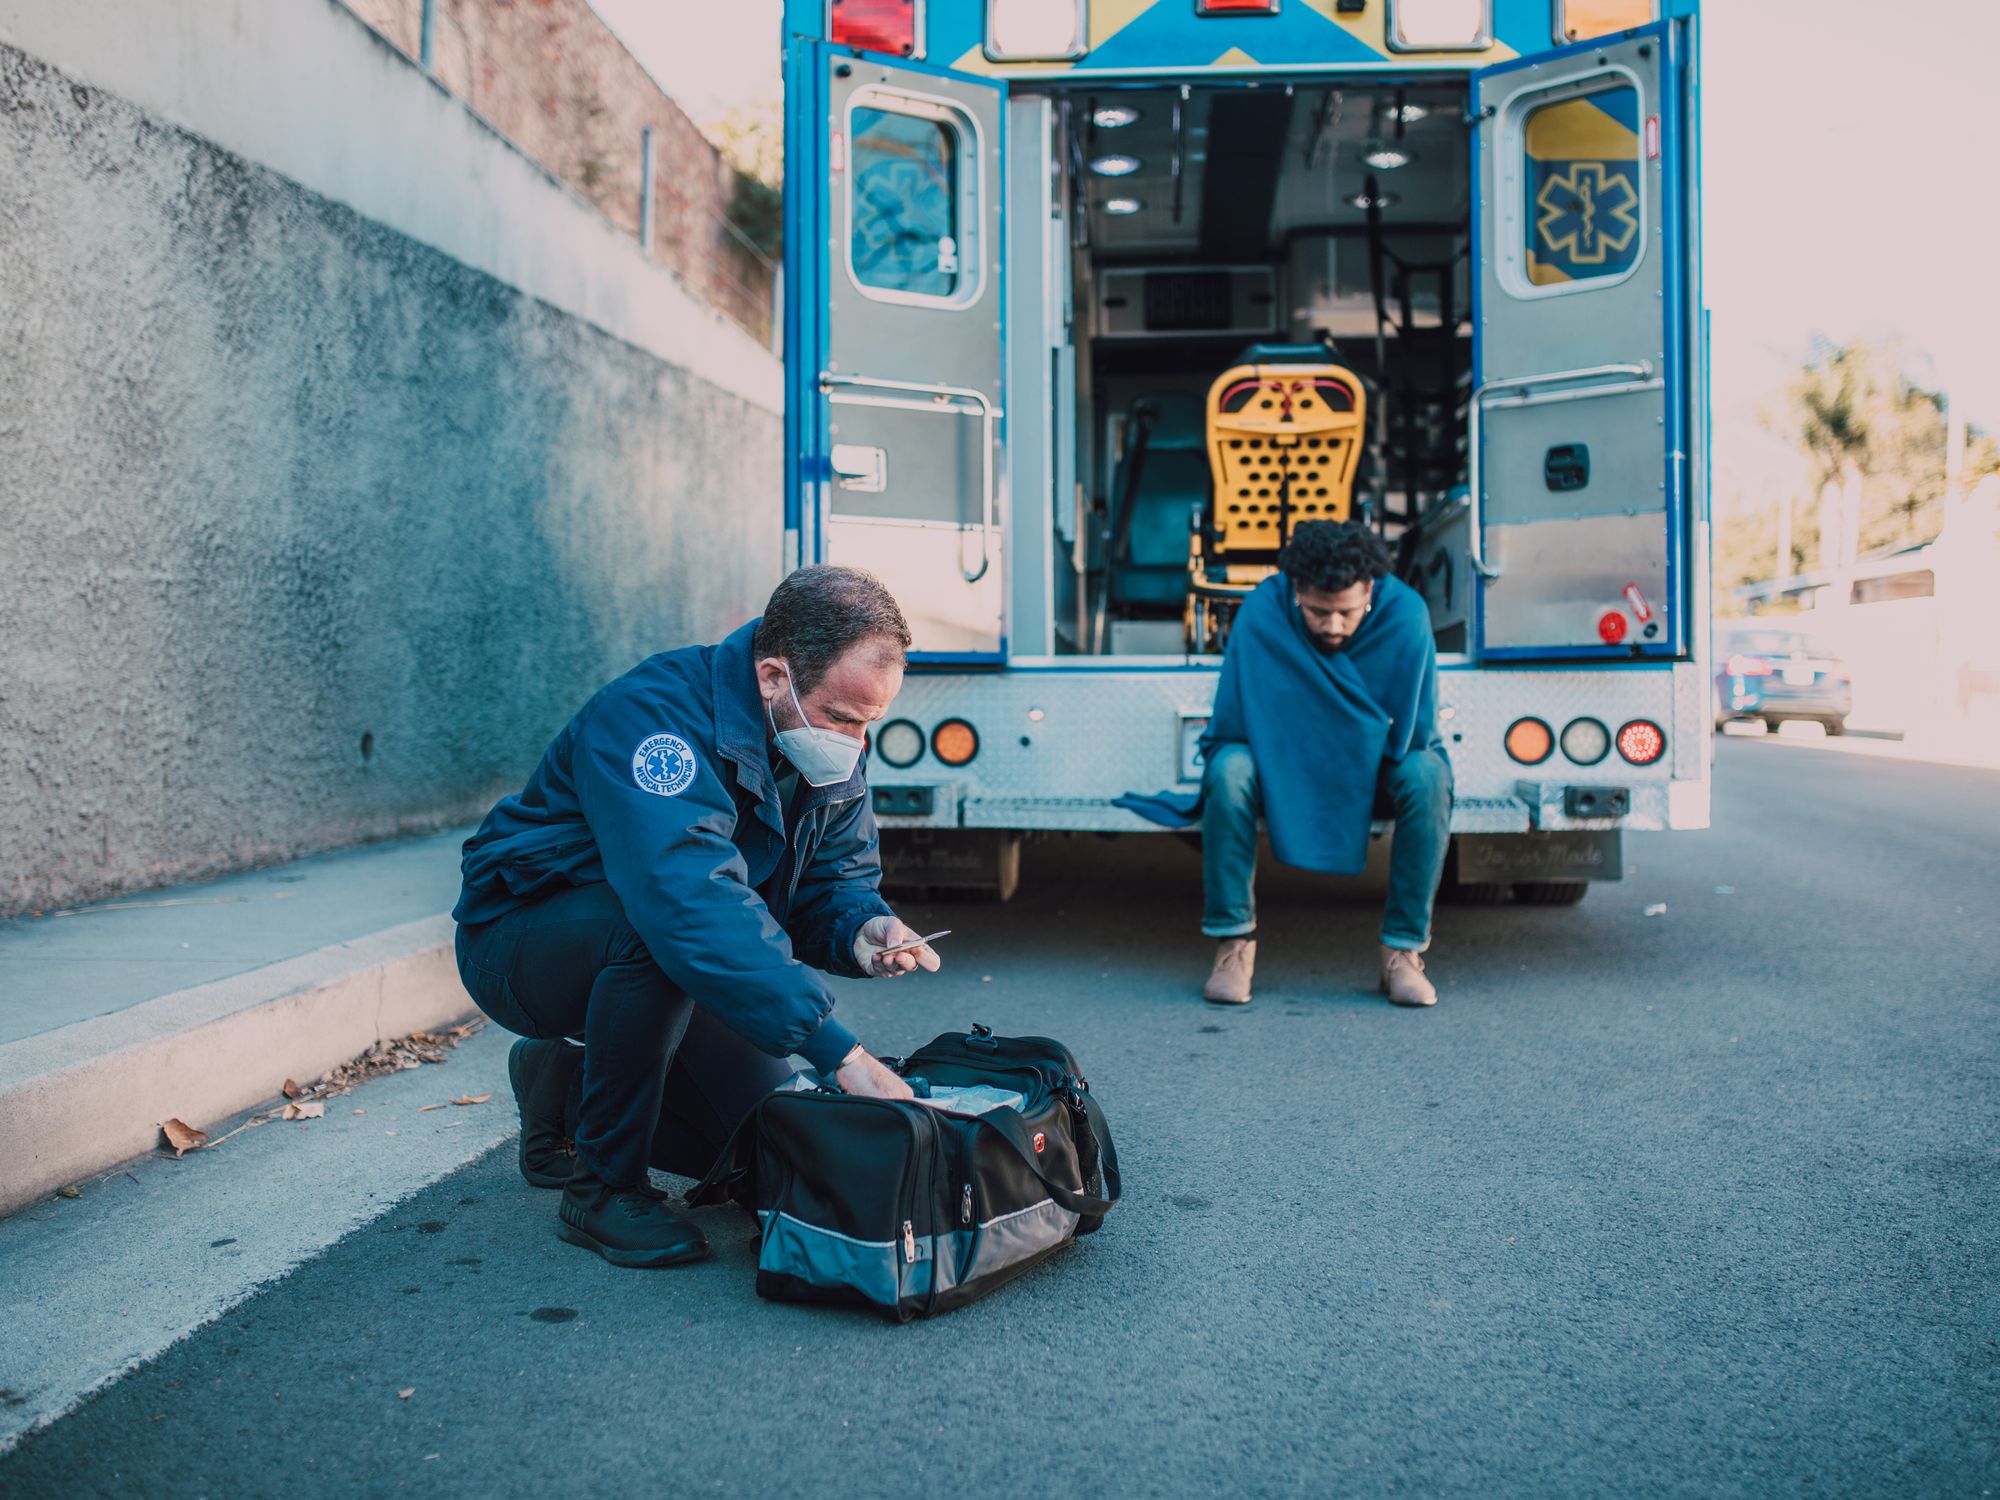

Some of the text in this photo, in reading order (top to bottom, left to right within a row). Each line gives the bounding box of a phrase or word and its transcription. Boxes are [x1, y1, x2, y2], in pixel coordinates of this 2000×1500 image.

[638, 737, 687, 758] EMERGENCY
[635, 759, 693, 793] MEDICAL TECHNICIAN
[1545, 842, 1603, 870] Made
